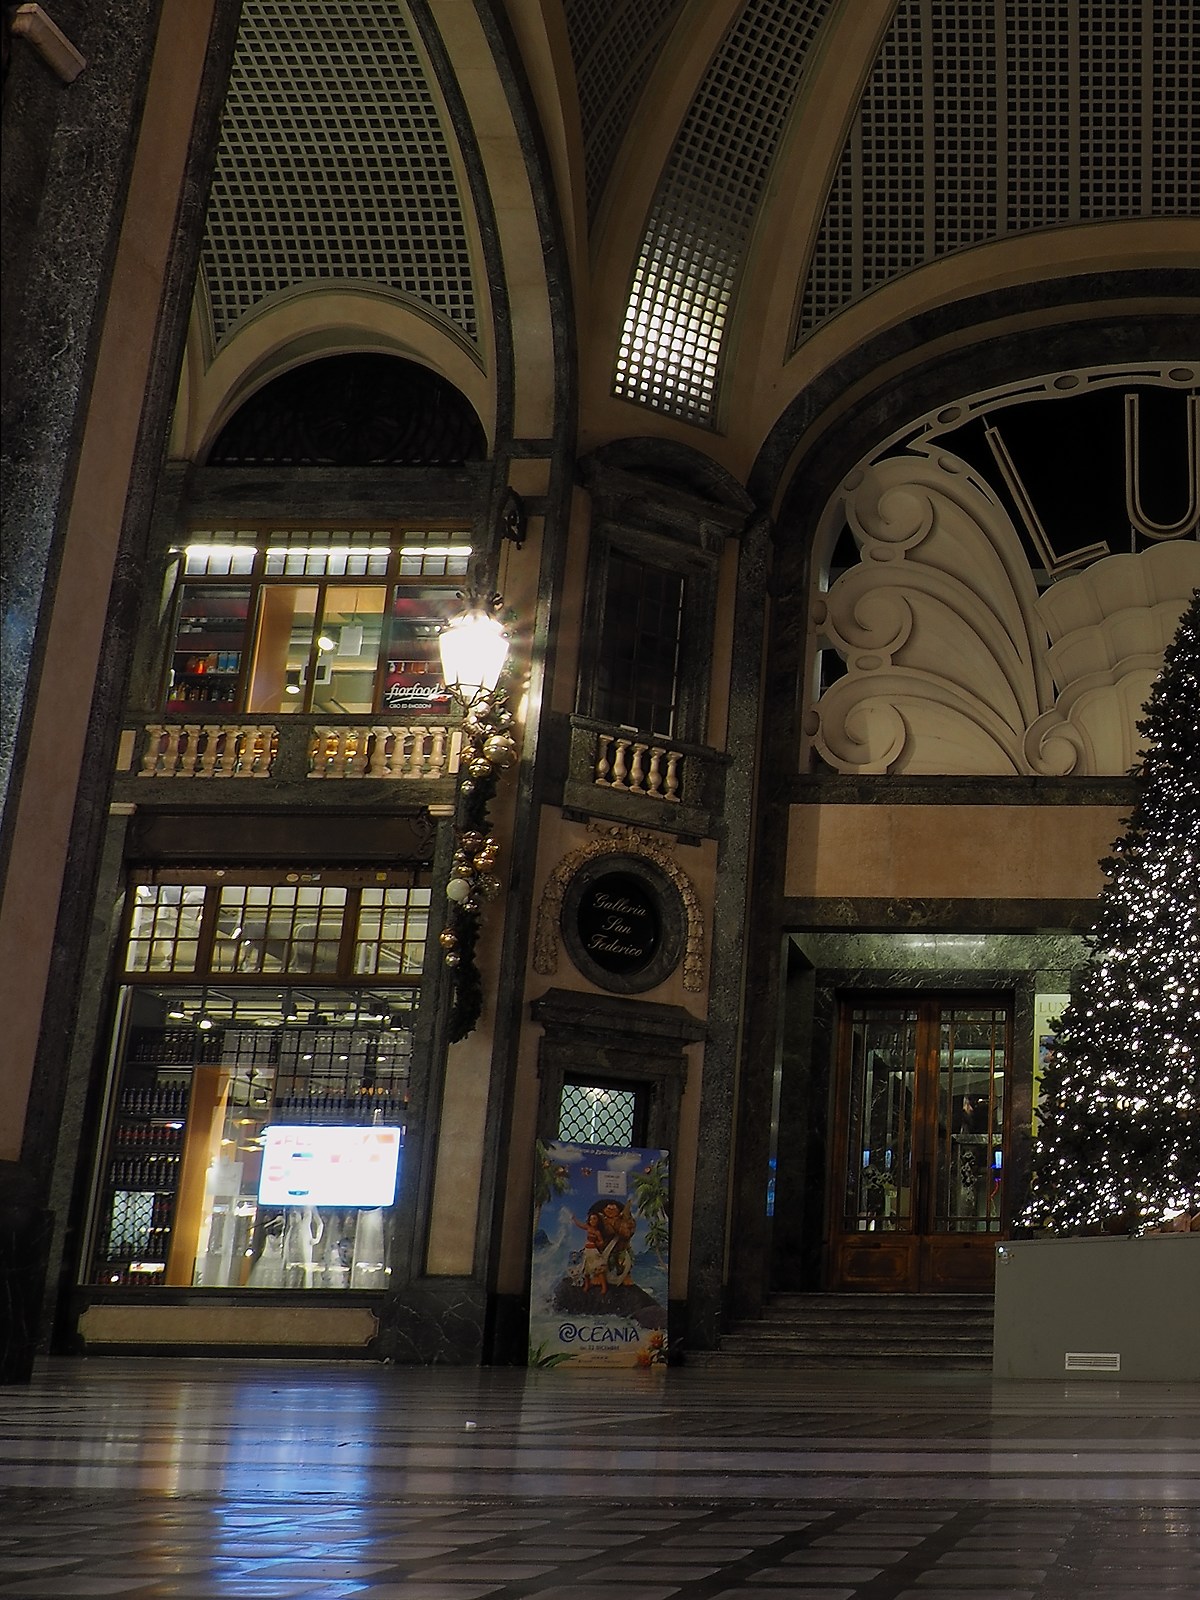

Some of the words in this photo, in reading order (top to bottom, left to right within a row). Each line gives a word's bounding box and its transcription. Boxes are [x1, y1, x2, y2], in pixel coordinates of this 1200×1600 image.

[384, 682, 443, 701] fiorfood
[593, 892, 647, 916] Galleria
[602, 915, 632, 934] San
[587, 933, 643, 957] Federico
[558, 1322, 640, 1343] OCEANIA
